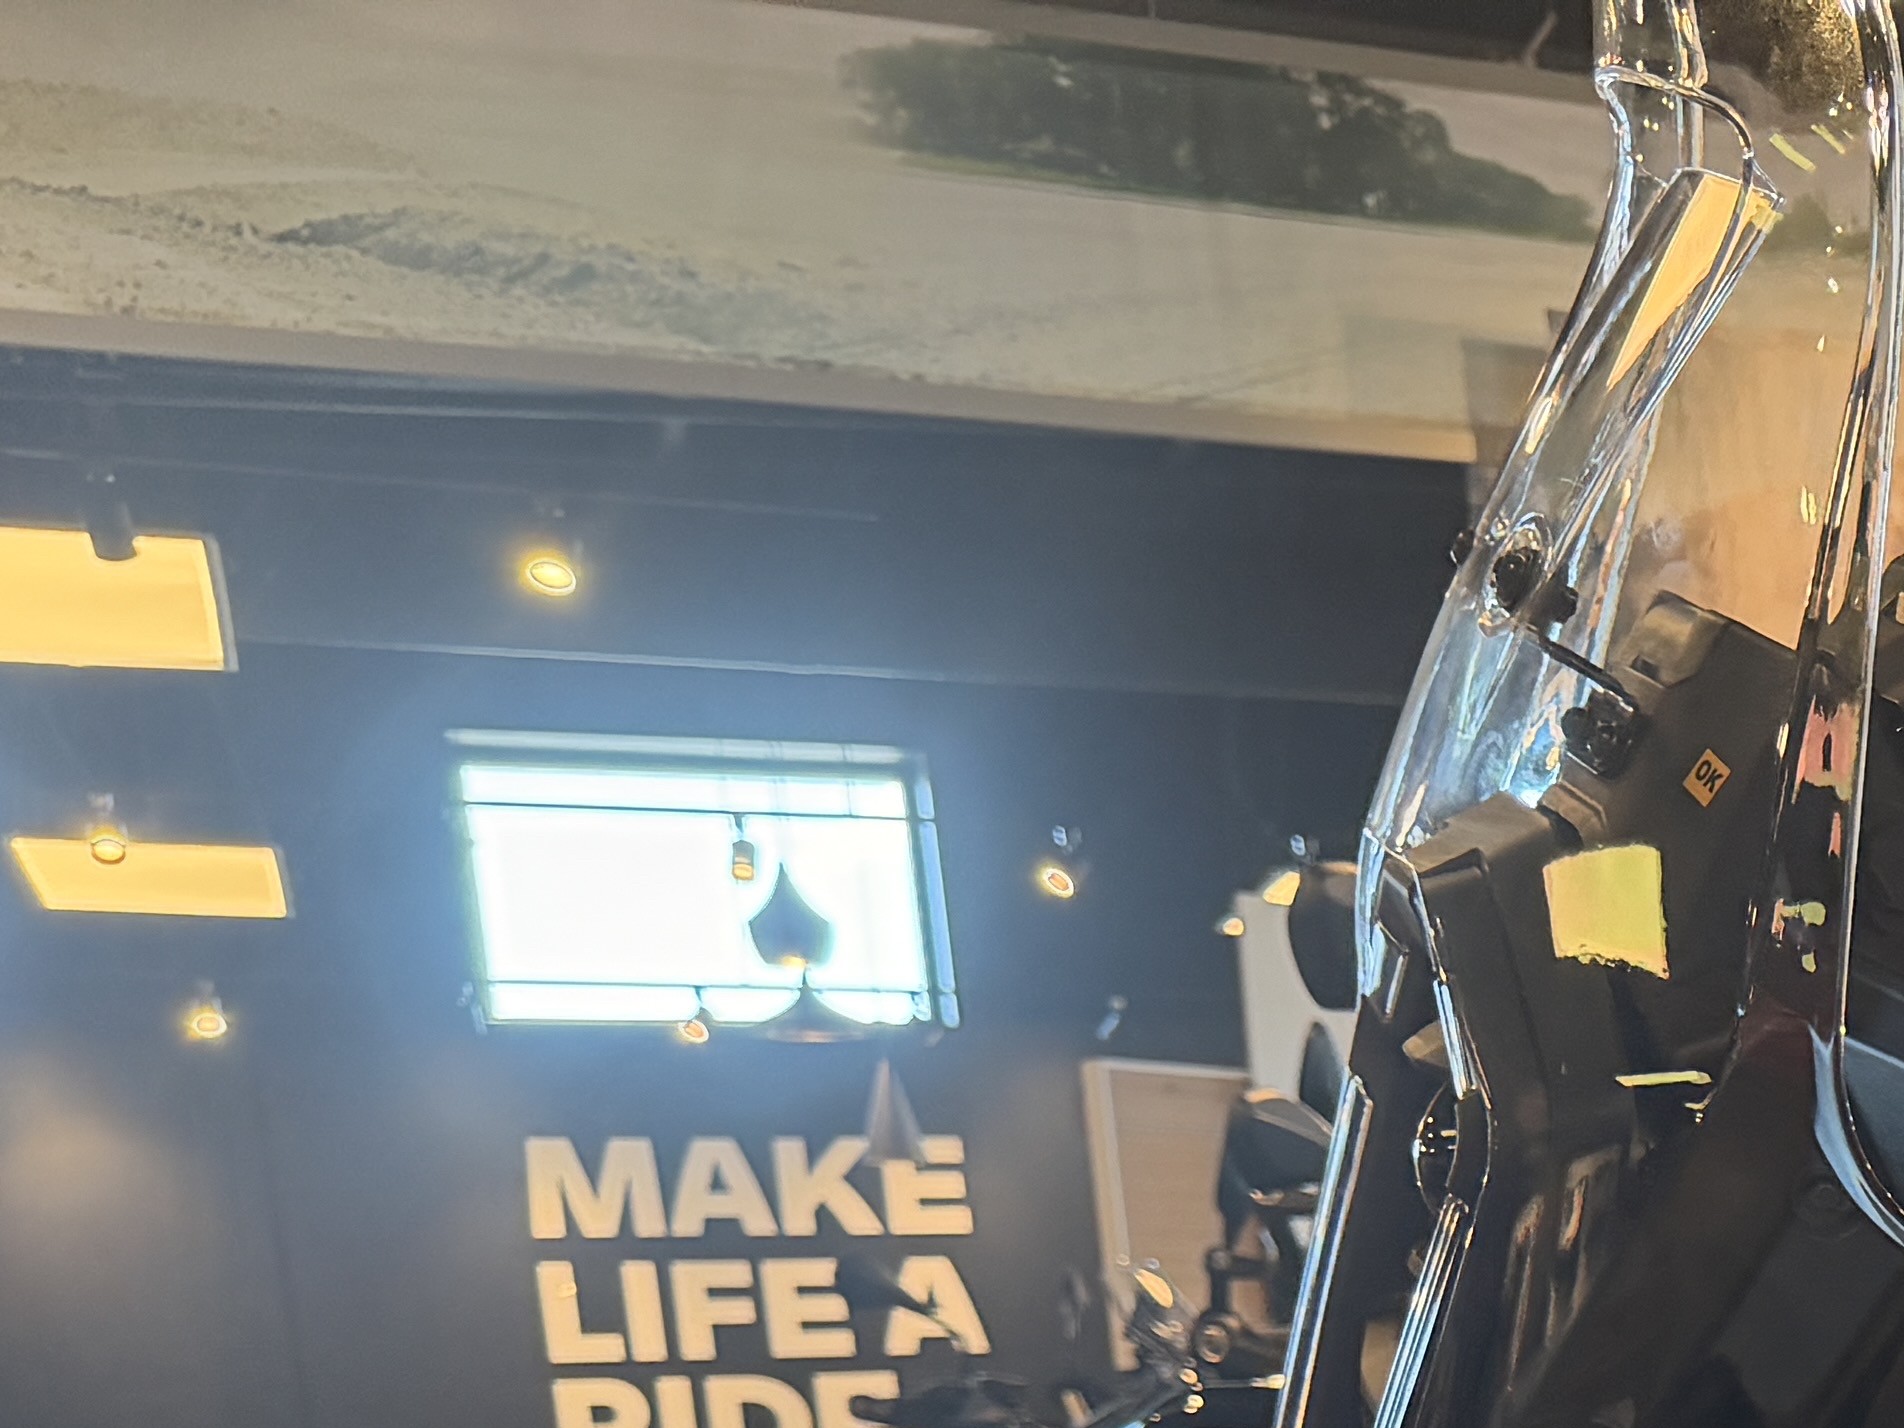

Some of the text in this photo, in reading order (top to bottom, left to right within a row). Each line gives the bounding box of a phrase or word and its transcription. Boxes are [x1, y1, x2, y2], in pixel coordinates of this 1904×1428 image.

[1695, 760, 1723, 793] OK
[523, 1135, 975, 1240] MAKE
[535, 1255, 991, 1364] LIFE A
